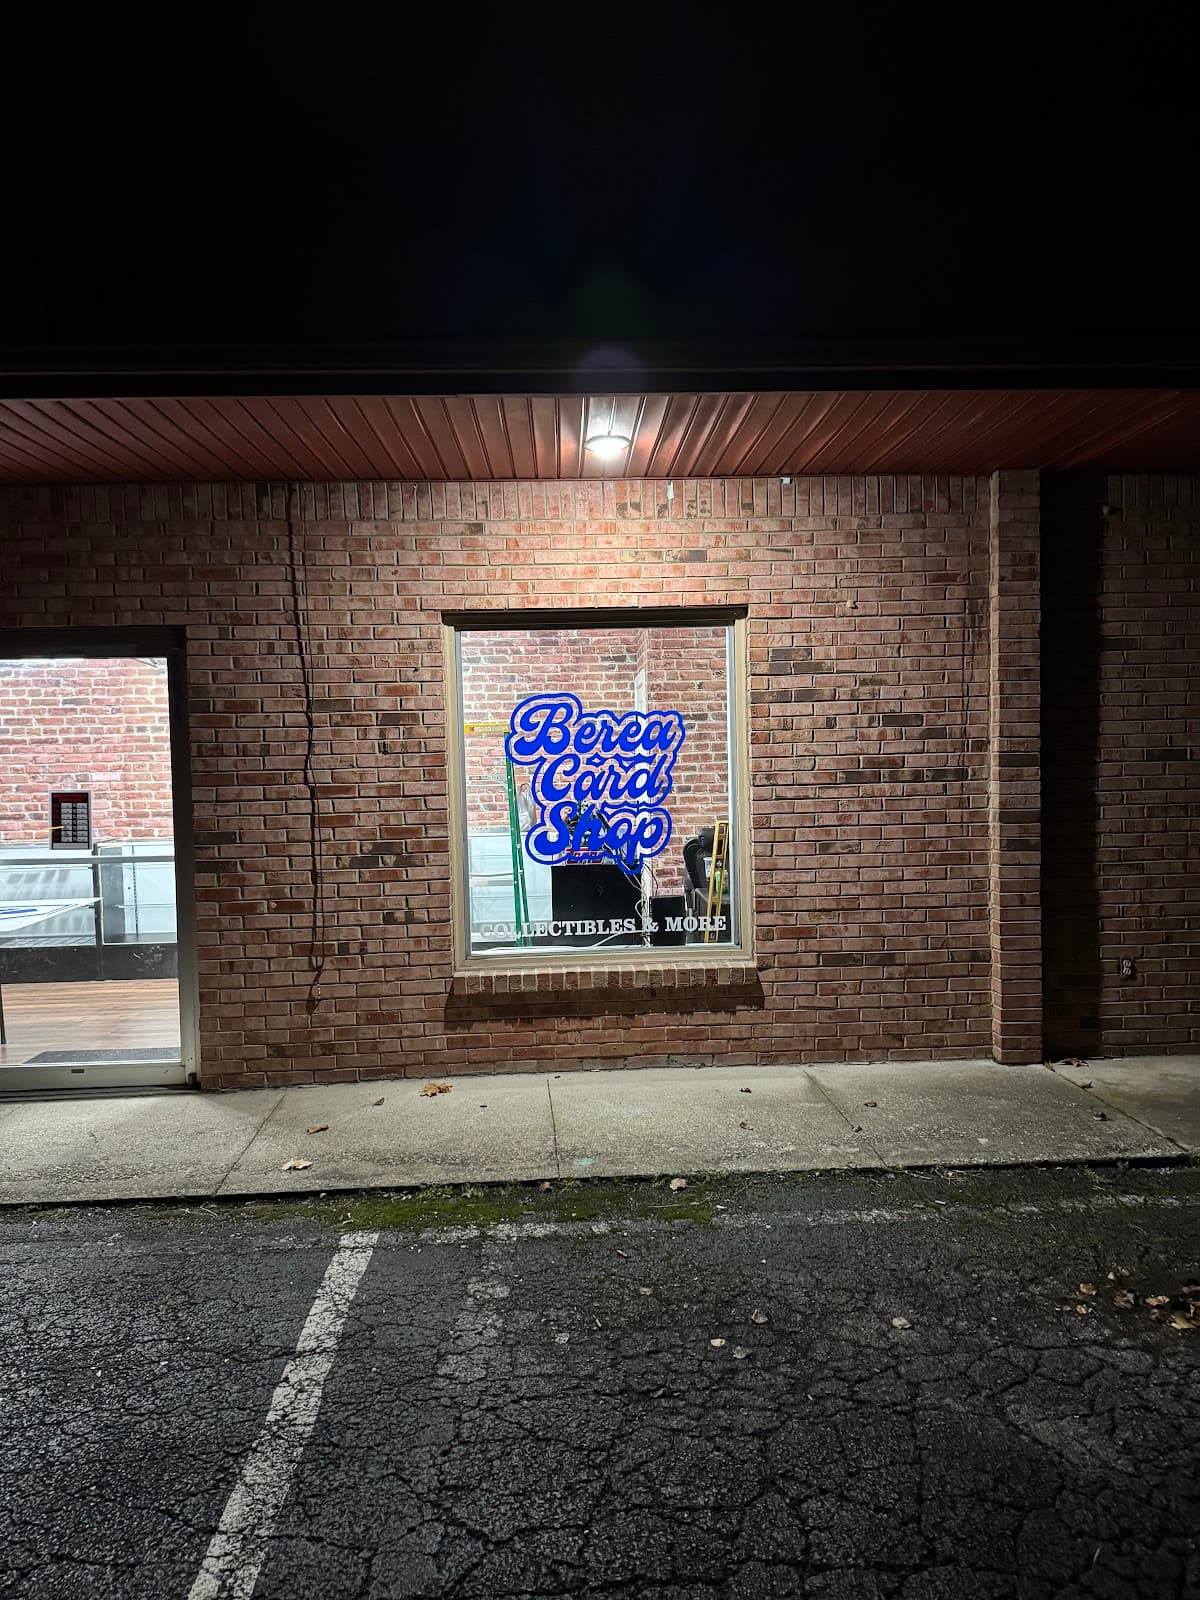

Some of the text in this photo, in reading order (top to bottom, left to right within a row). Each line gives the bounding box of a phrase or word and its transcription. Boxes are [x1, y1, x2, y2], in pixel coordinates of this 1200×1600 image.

[513, 702, 677, 755] Berea
[541, 754, 664, 802] Card
[534, 801, 665, 866] Shop
[480, 915, 727, 938] COLLECTIBLES & MORE
